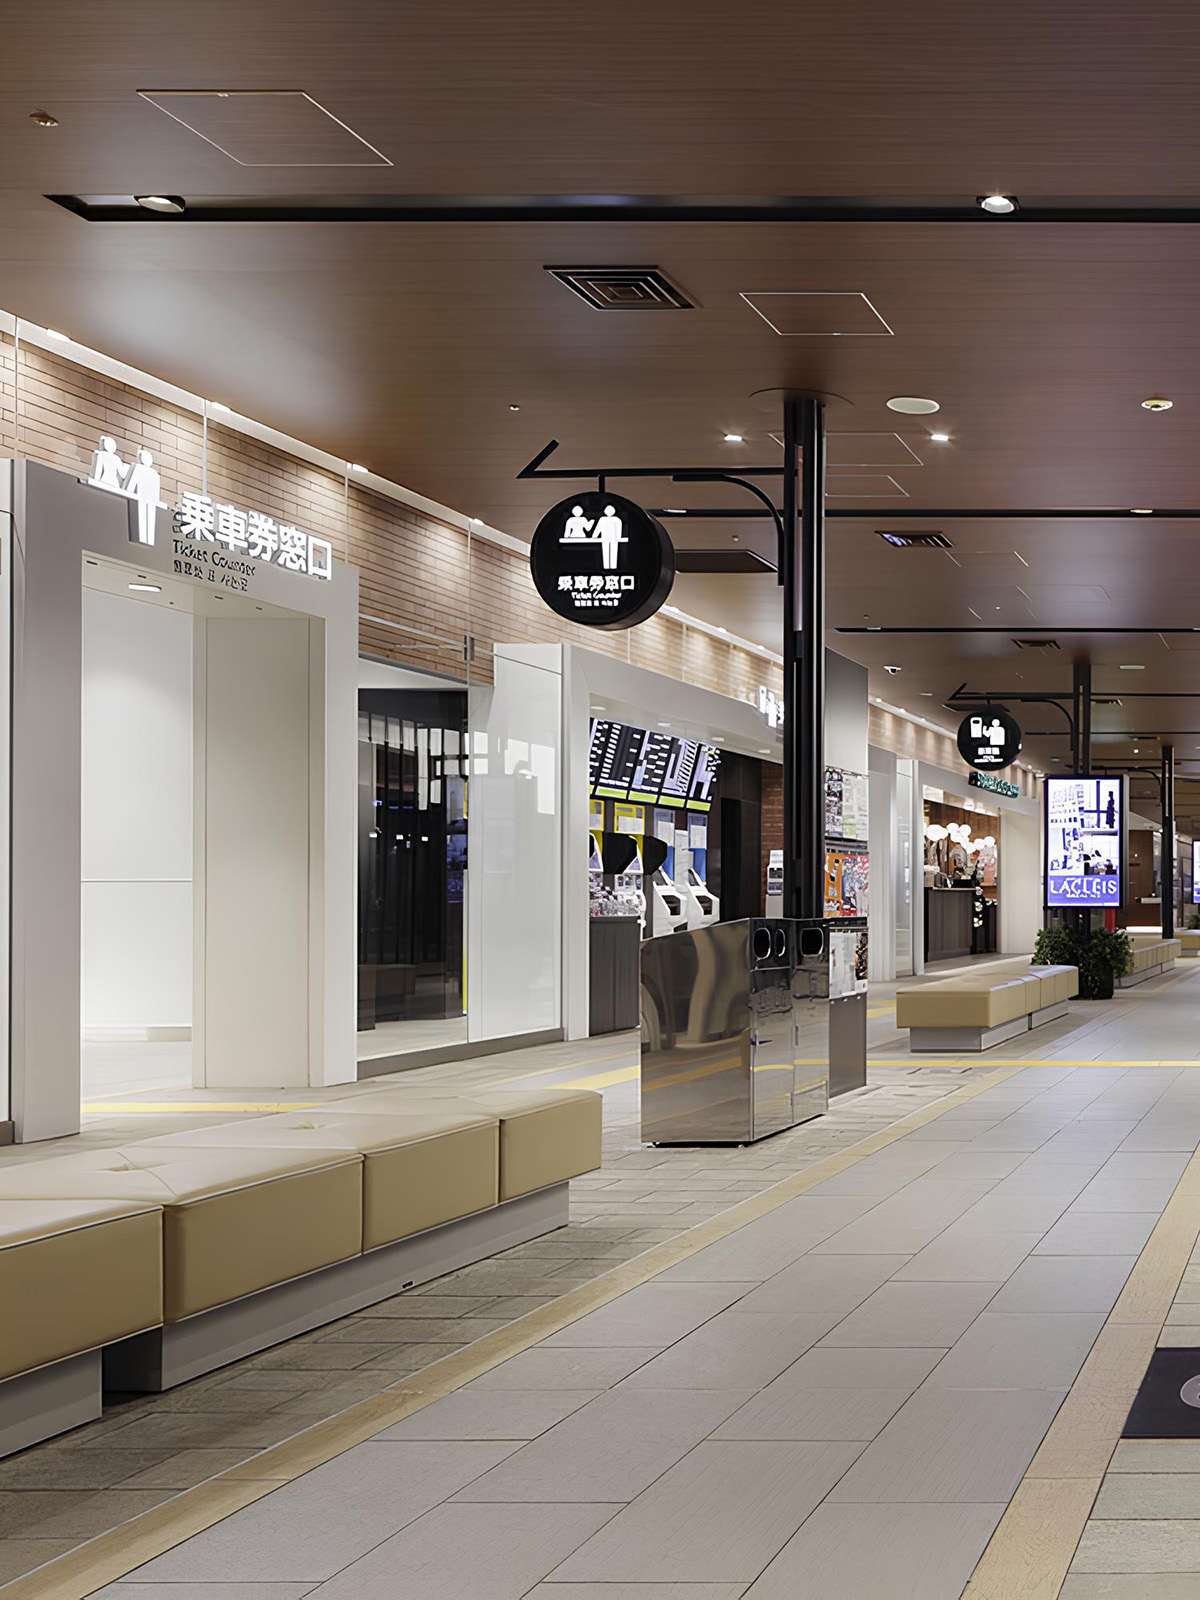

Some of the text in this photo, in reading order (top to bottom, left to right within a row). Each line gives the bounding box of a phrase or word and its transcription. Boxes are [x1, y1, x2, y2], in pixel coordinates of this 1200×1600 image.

[179, 491, 332, 580] 乗車券窓口
